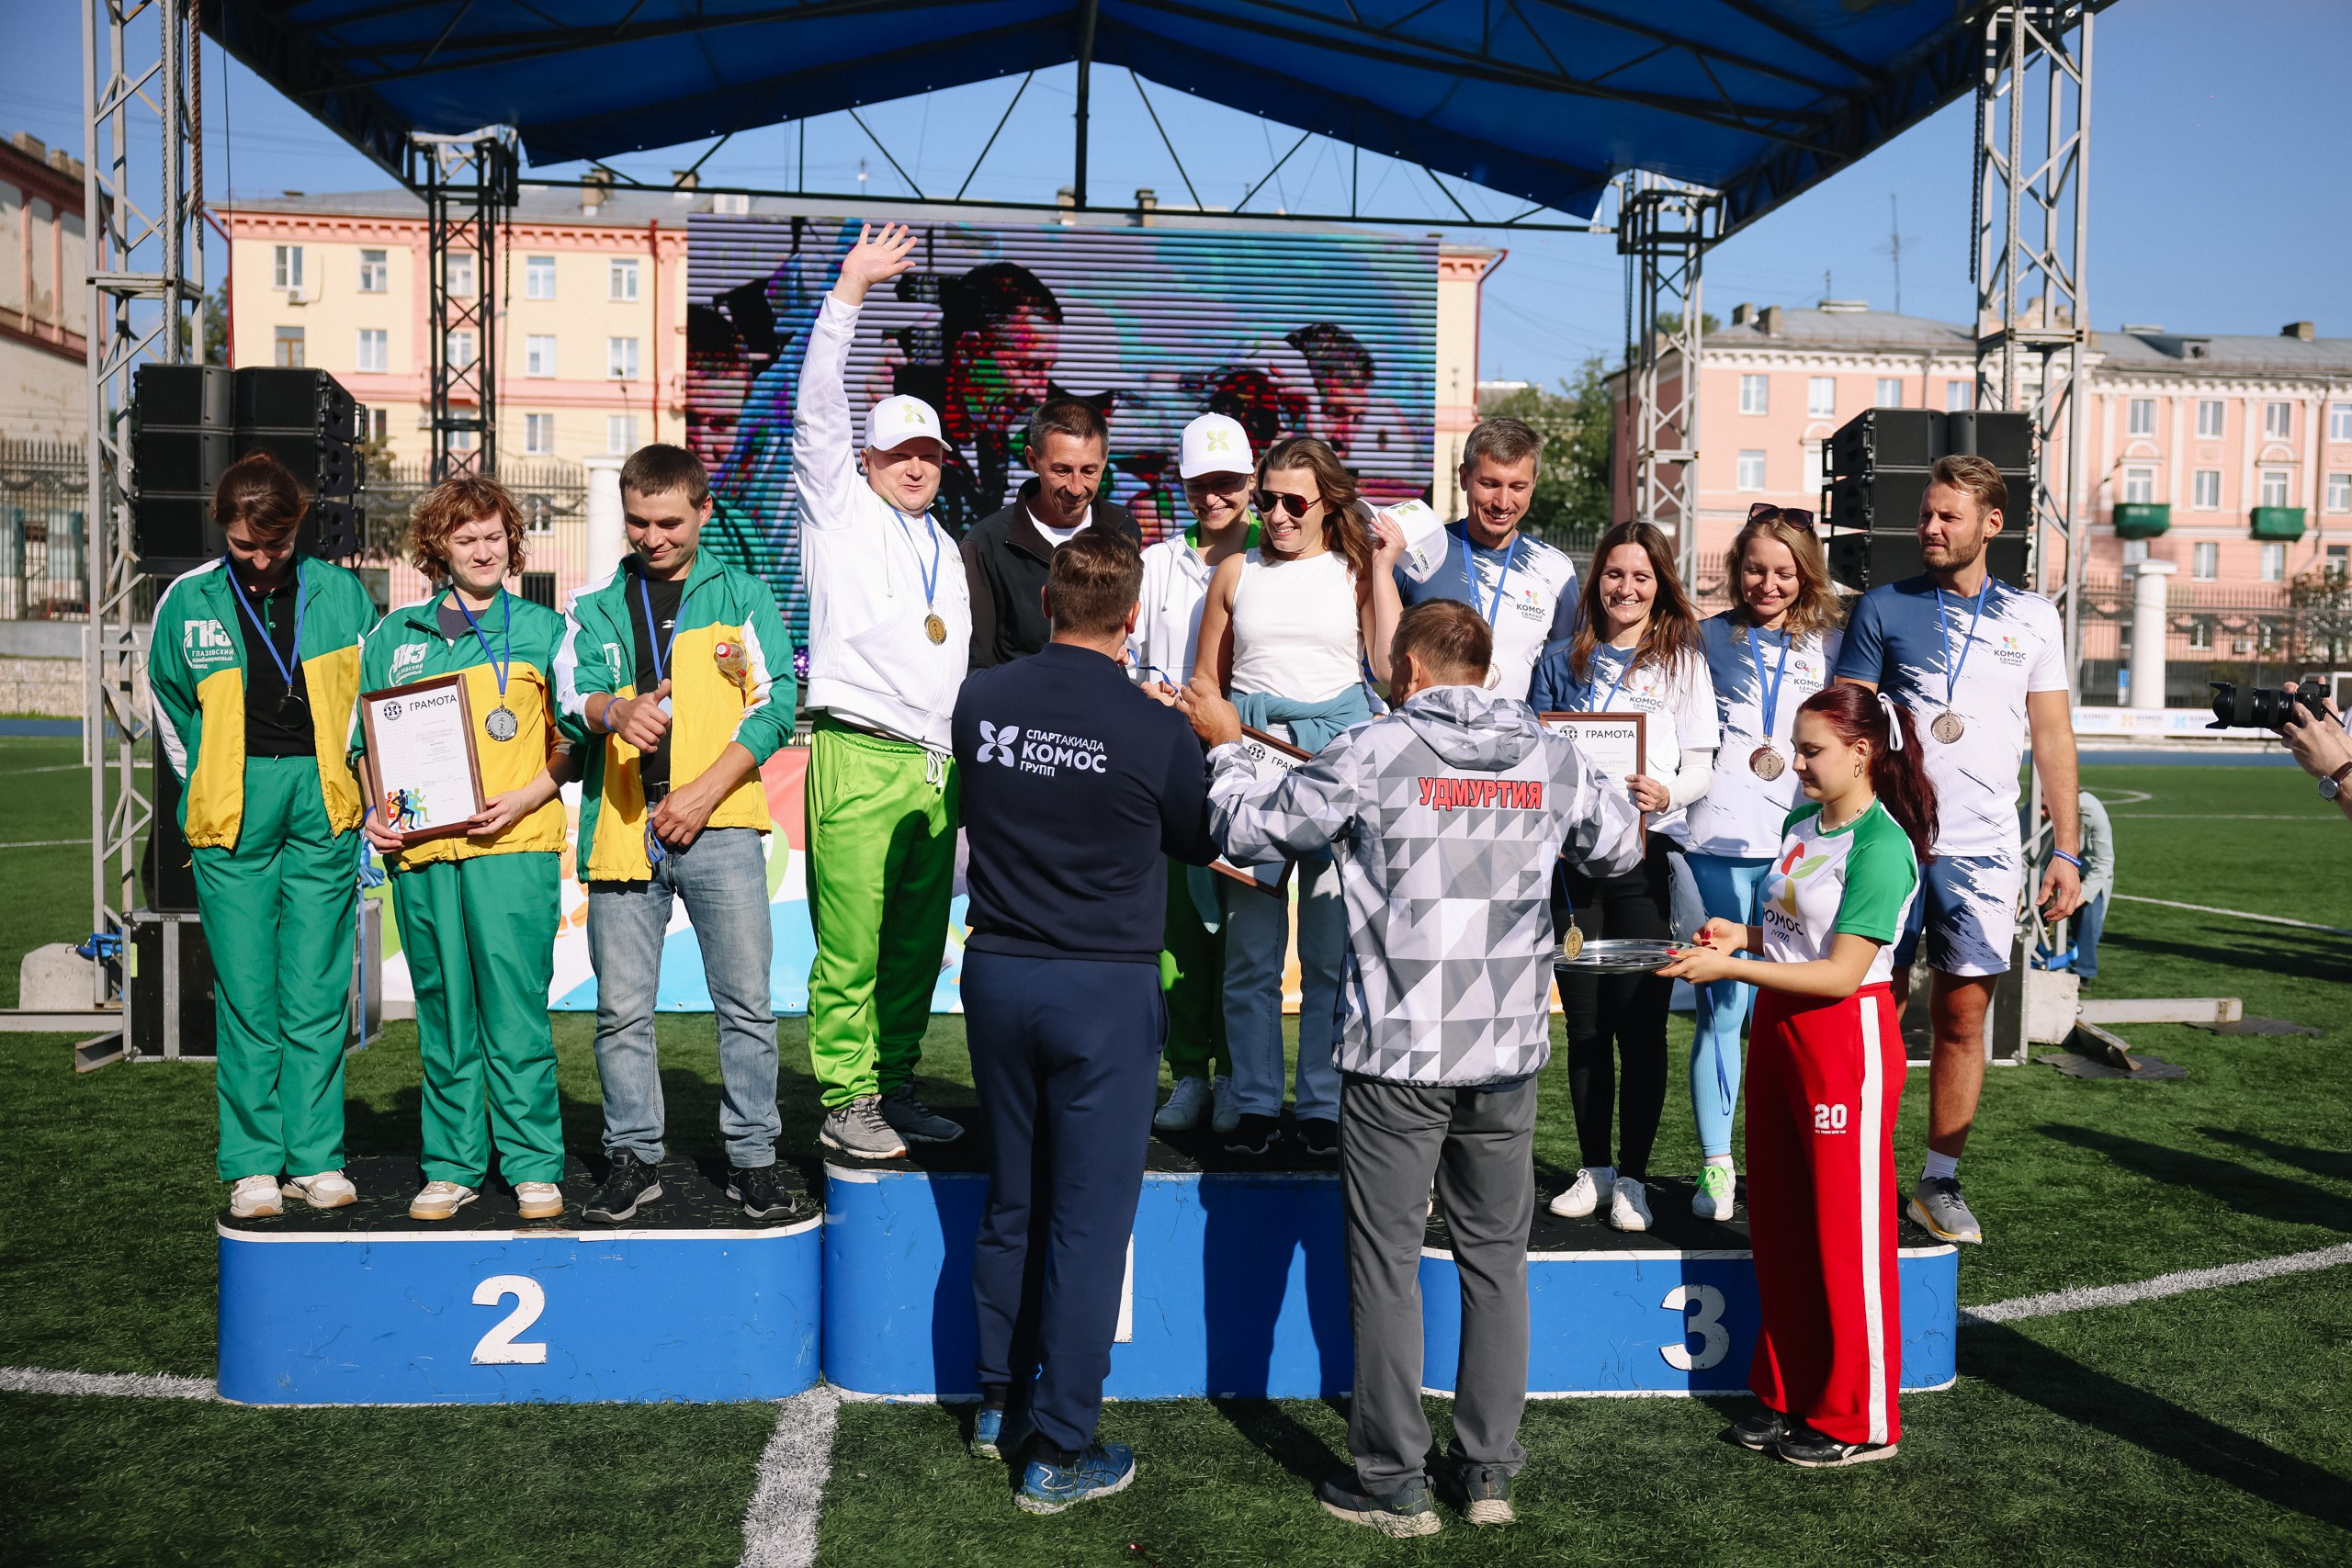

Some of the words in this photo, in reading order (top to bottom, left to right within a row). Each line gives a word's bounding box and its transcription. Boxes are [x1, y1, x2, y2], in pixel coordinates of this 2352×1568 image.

[1516, 604, 1546, 616] КОМОС
[191, 648, 234, 657] ГЛАЗОВСКИЙ
[1994, 649, 2027, 660] КОМОС
[1793, 678, 1824, 690] КОМОС
[409, 694, 458, 712] ГРАМОТА
[1629, 696, 1663, 708] КОМОС
[1025, 728, 1104, 752] СПАРТАКИАДА
[1585, 729, 1635, 739] ГРАМОТА
[1021, 740, 1108, 773] КОМОС
[1271, 756, 1297, 773] ГРАМ
[1019, 761, 1056, 777] ГРУПП
[1418, 777, 1543, 812] УДМУРТИЯ
[1763, 907, 1804, 936] ОМОС
[1815, 1103, 1848, 1130] 20
[470, 1274, 547, 1366] 2
[1658, 1283, 1730, 1371] 3
